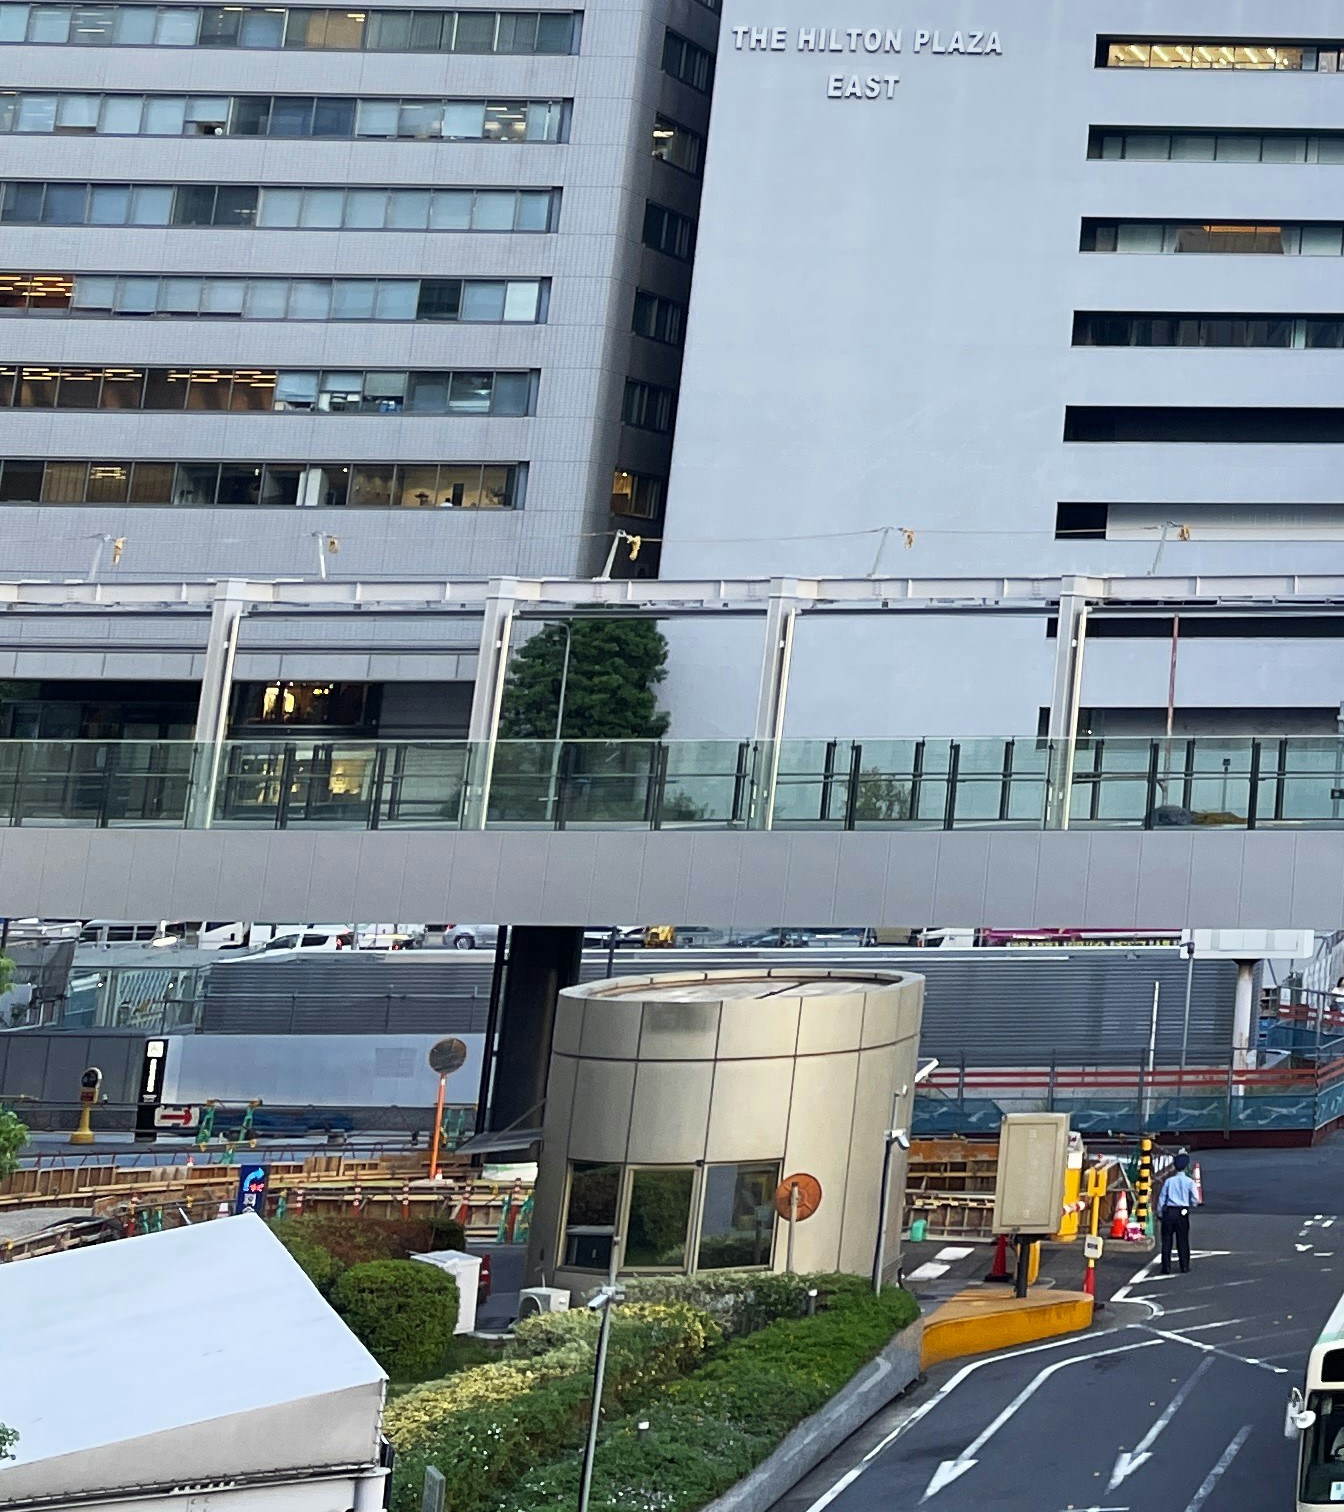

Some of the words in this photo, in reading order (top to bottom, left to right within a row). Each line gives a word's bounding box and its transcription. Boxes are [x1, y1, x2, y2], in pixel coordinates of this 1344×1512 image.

[732, 26, 787, 51] THE
[797, 28, 902, 54] HILTON
[913, 29, 1003, 55] PLAZA
[827, 74, 900, 99] EAST
